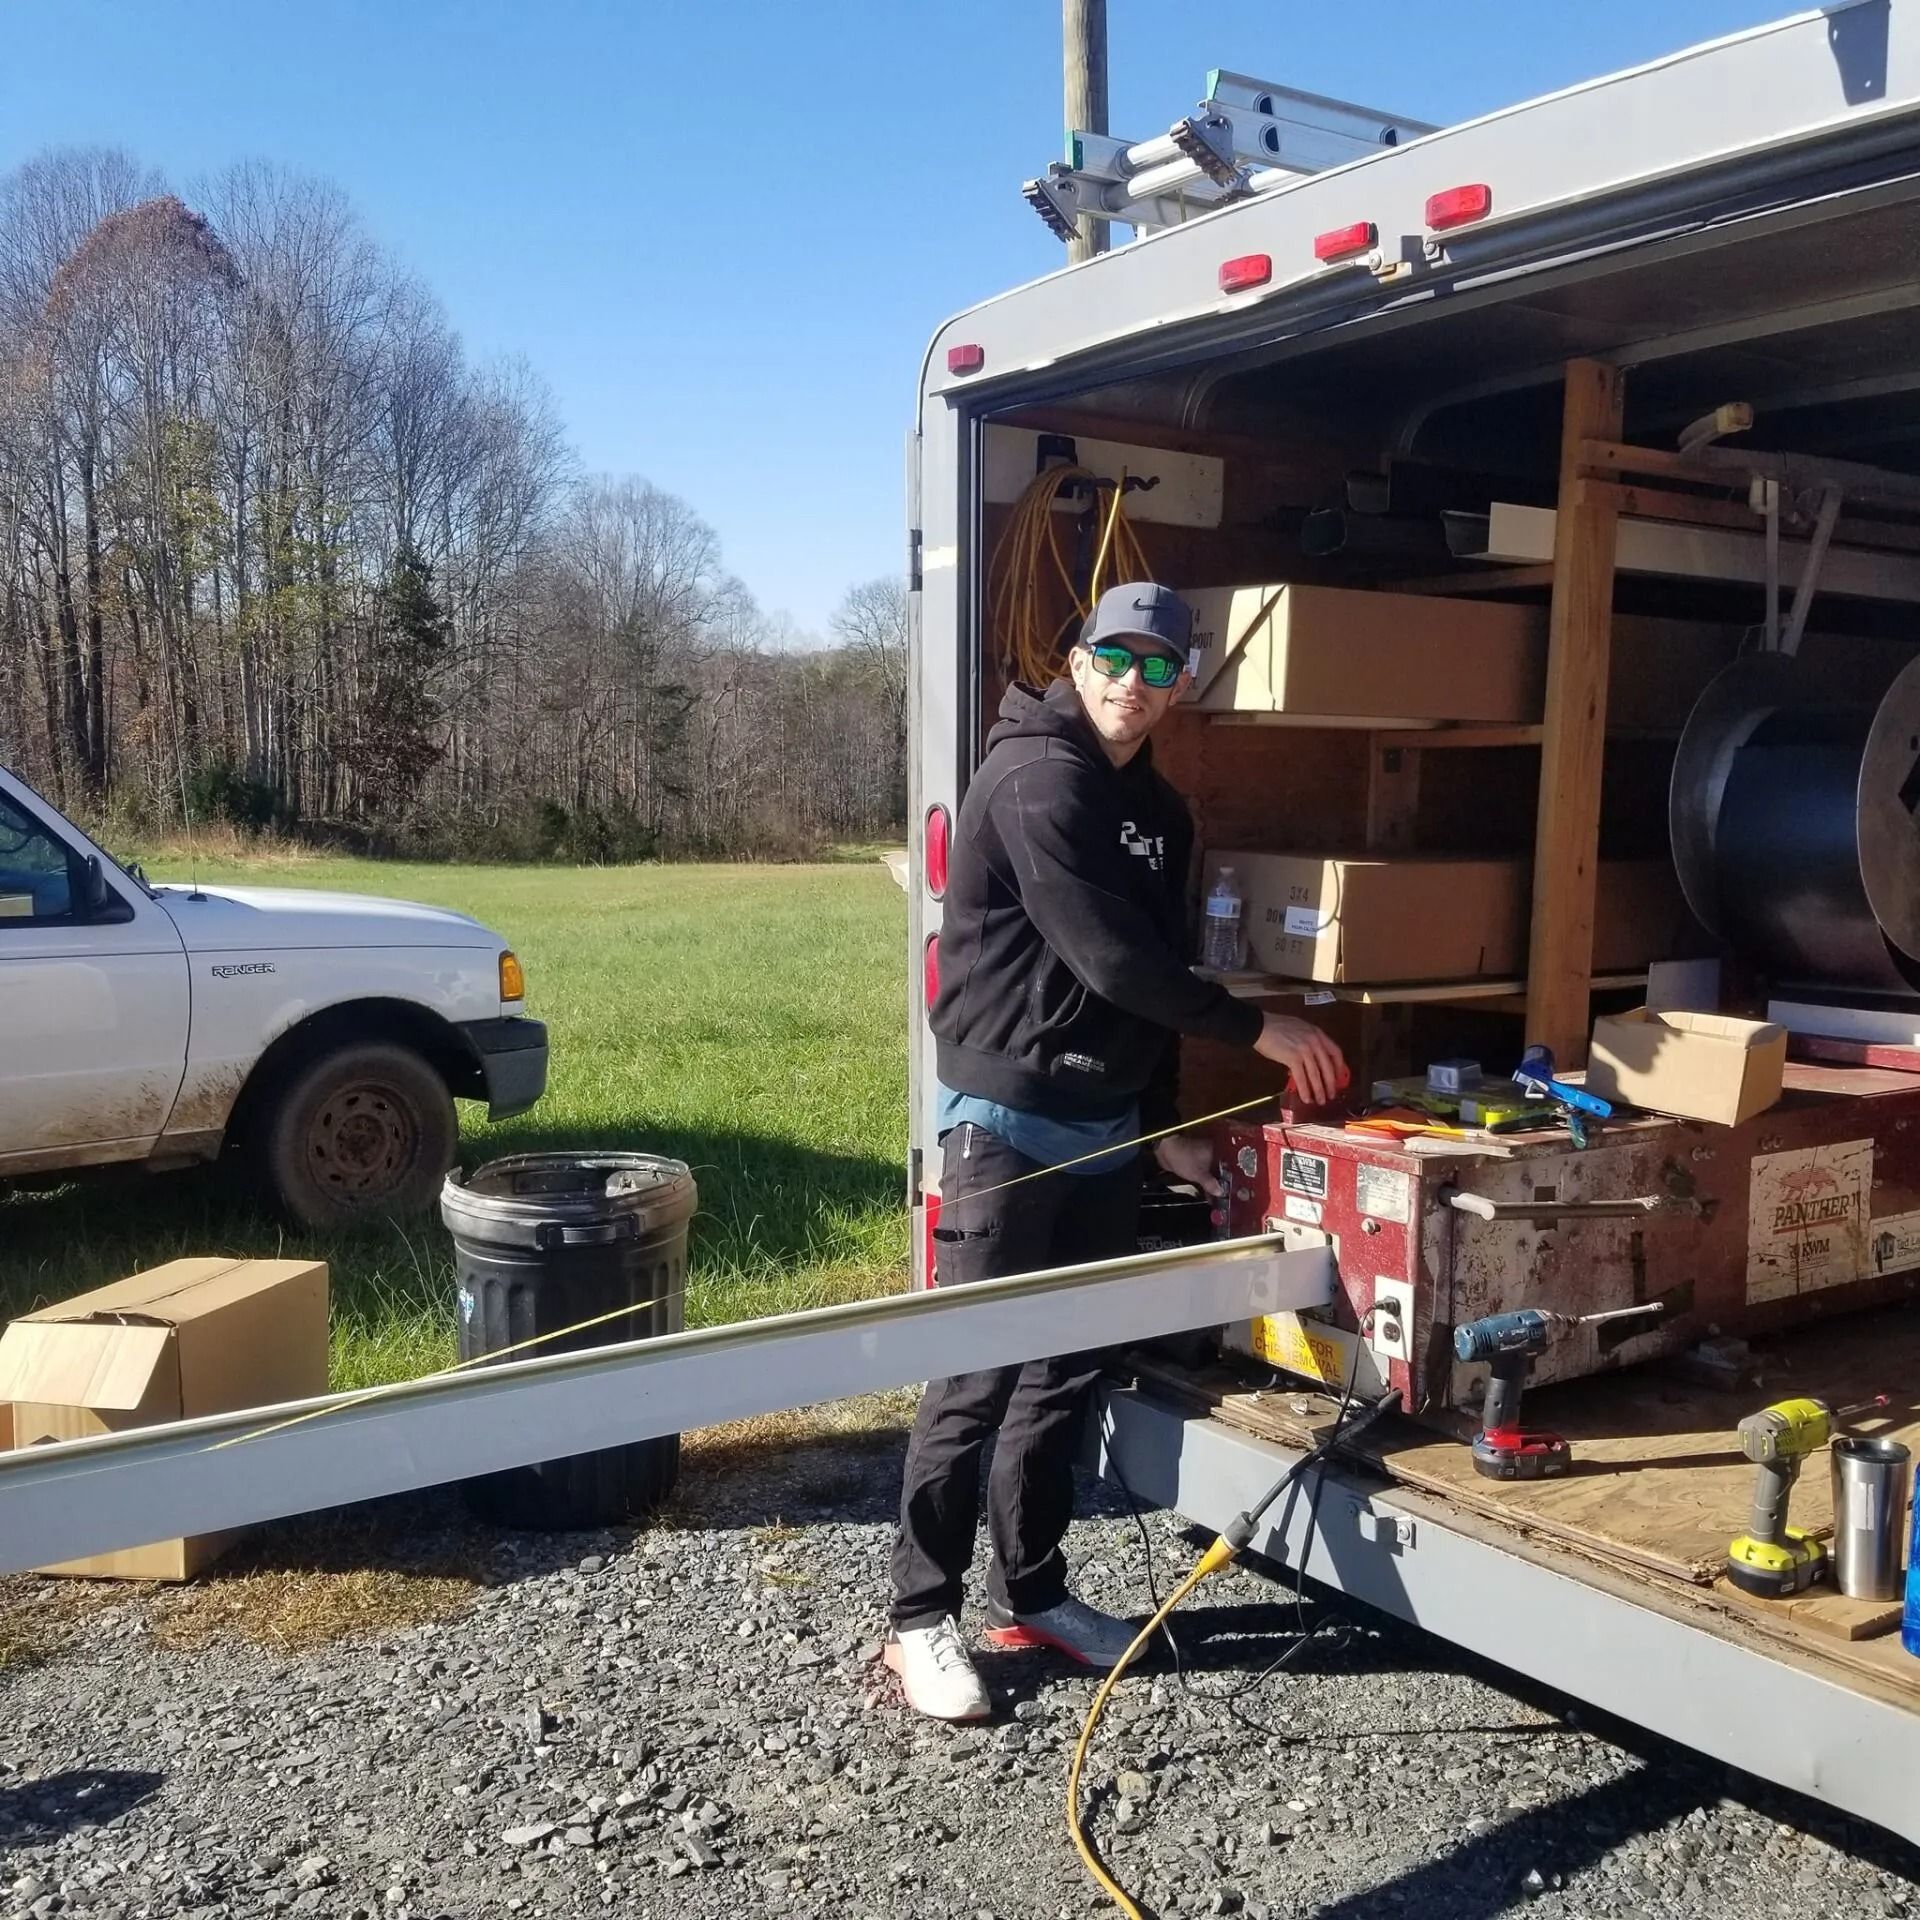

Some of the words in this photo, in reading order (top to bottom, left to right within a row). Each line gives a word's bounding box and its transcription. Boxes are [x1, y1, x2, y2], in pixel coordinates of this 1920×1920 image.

[212, 963, 275, 978] RANGER
[1773, 1194, 1850, 1228] PANTHER
[1309, 1338, 1334, 1359] FOR
